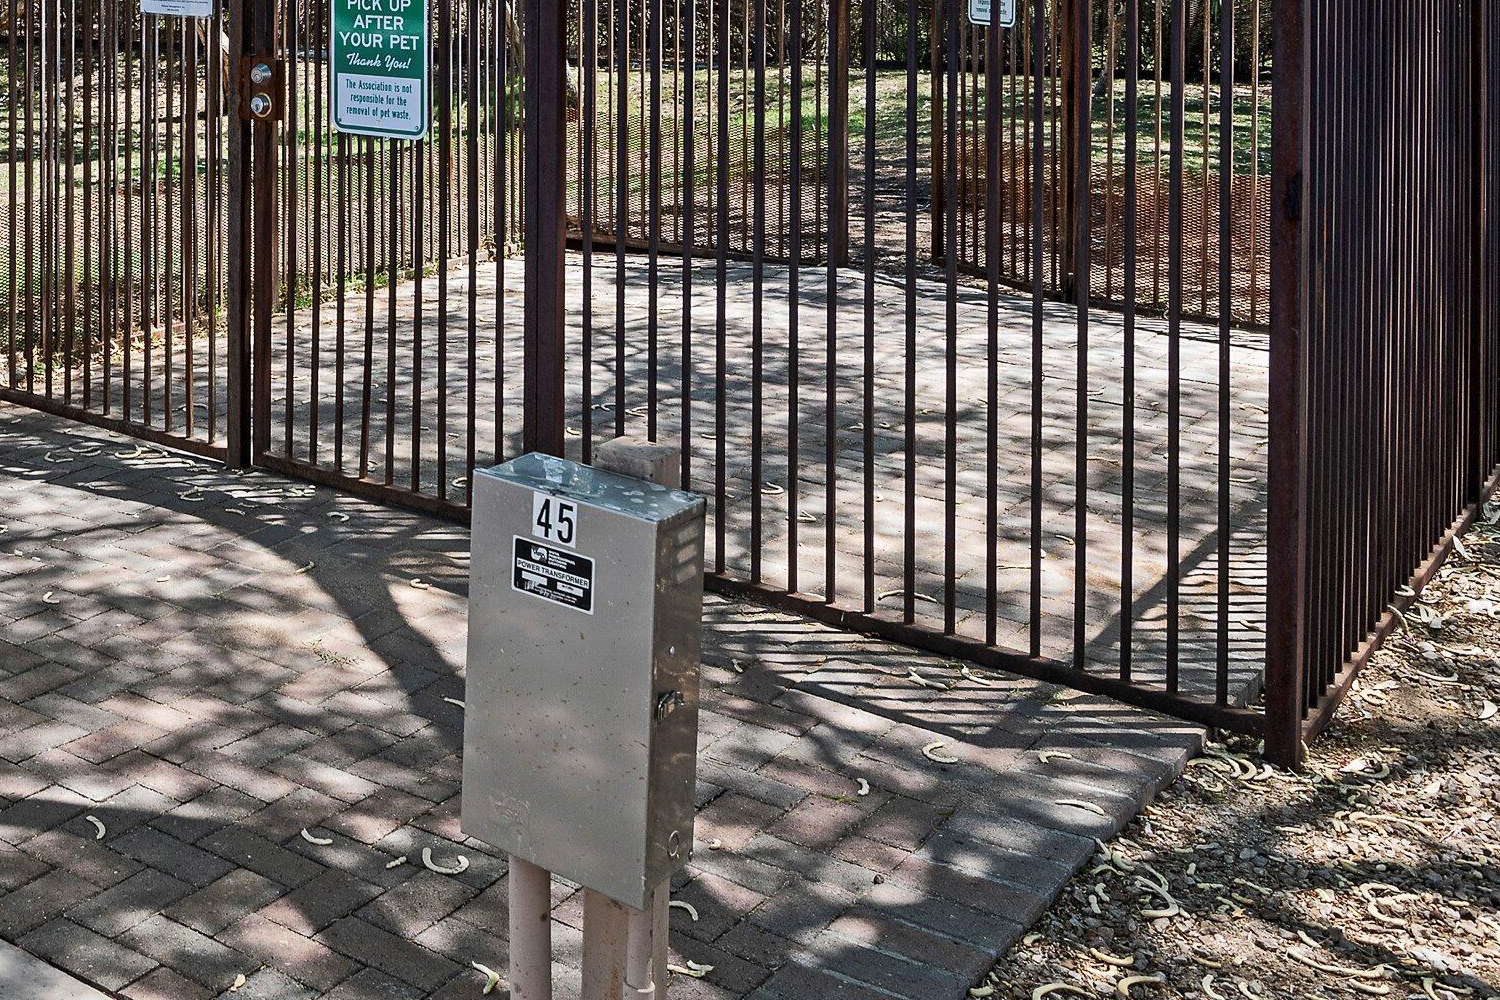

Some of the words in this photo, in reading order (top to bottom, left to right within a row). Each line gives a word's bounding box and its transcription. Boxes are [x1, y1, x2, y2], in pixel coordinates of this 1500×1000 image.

[353, 14, 404, 31] AFTER
[339, 31, 383, 48] YOUR
[389, 34, 420, 51] PET
[346, 52, 382, 68] Thank
[384, 54, 411, 72] You!
[346, 78, 357, 89] The
[358, 79, 393, 92] Association
[394, 83, 400, 92] is
[401, 83, 412, 94] not
[350, 93, 384, 106] responsible
[386, 94, 395, 105] for
[396, 96, 407, 106] the
[346, 105, 370, 117] removal
[371, 106, 379, 117] of
[380, 107, 390, 119] pet
[391, 109, 411, 120] waste.
[536, 498, 574, 544] 45
[517, 559, 541, 572] POWER
[541, 566, 589, 588] TRANSFORMER
